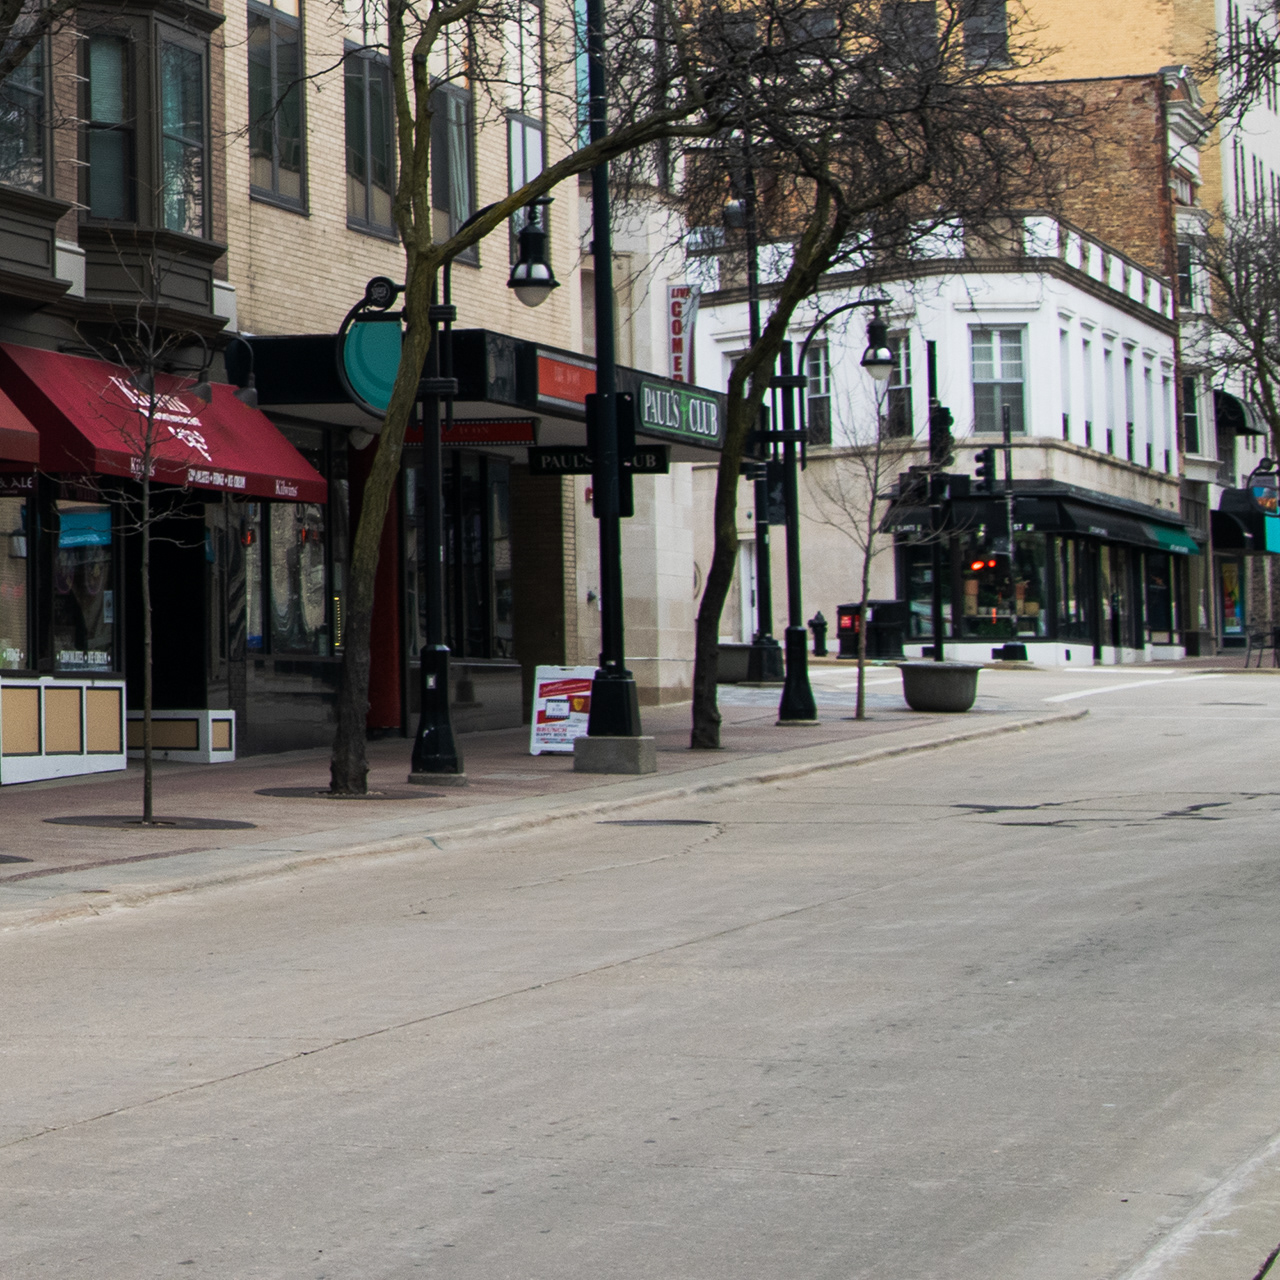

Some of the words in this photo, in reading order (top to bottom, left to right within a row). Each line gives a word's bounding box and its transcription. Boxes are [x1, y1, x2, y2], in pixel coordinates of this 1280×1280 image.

[643, 387, 680, 428] PAUL'S
[689, 398, 718, 436] CLUB
[541, 454, 594, 469] PAUL'S
[633, 454, 657, 468] UB
[10, 477, 33, 489] ALE
